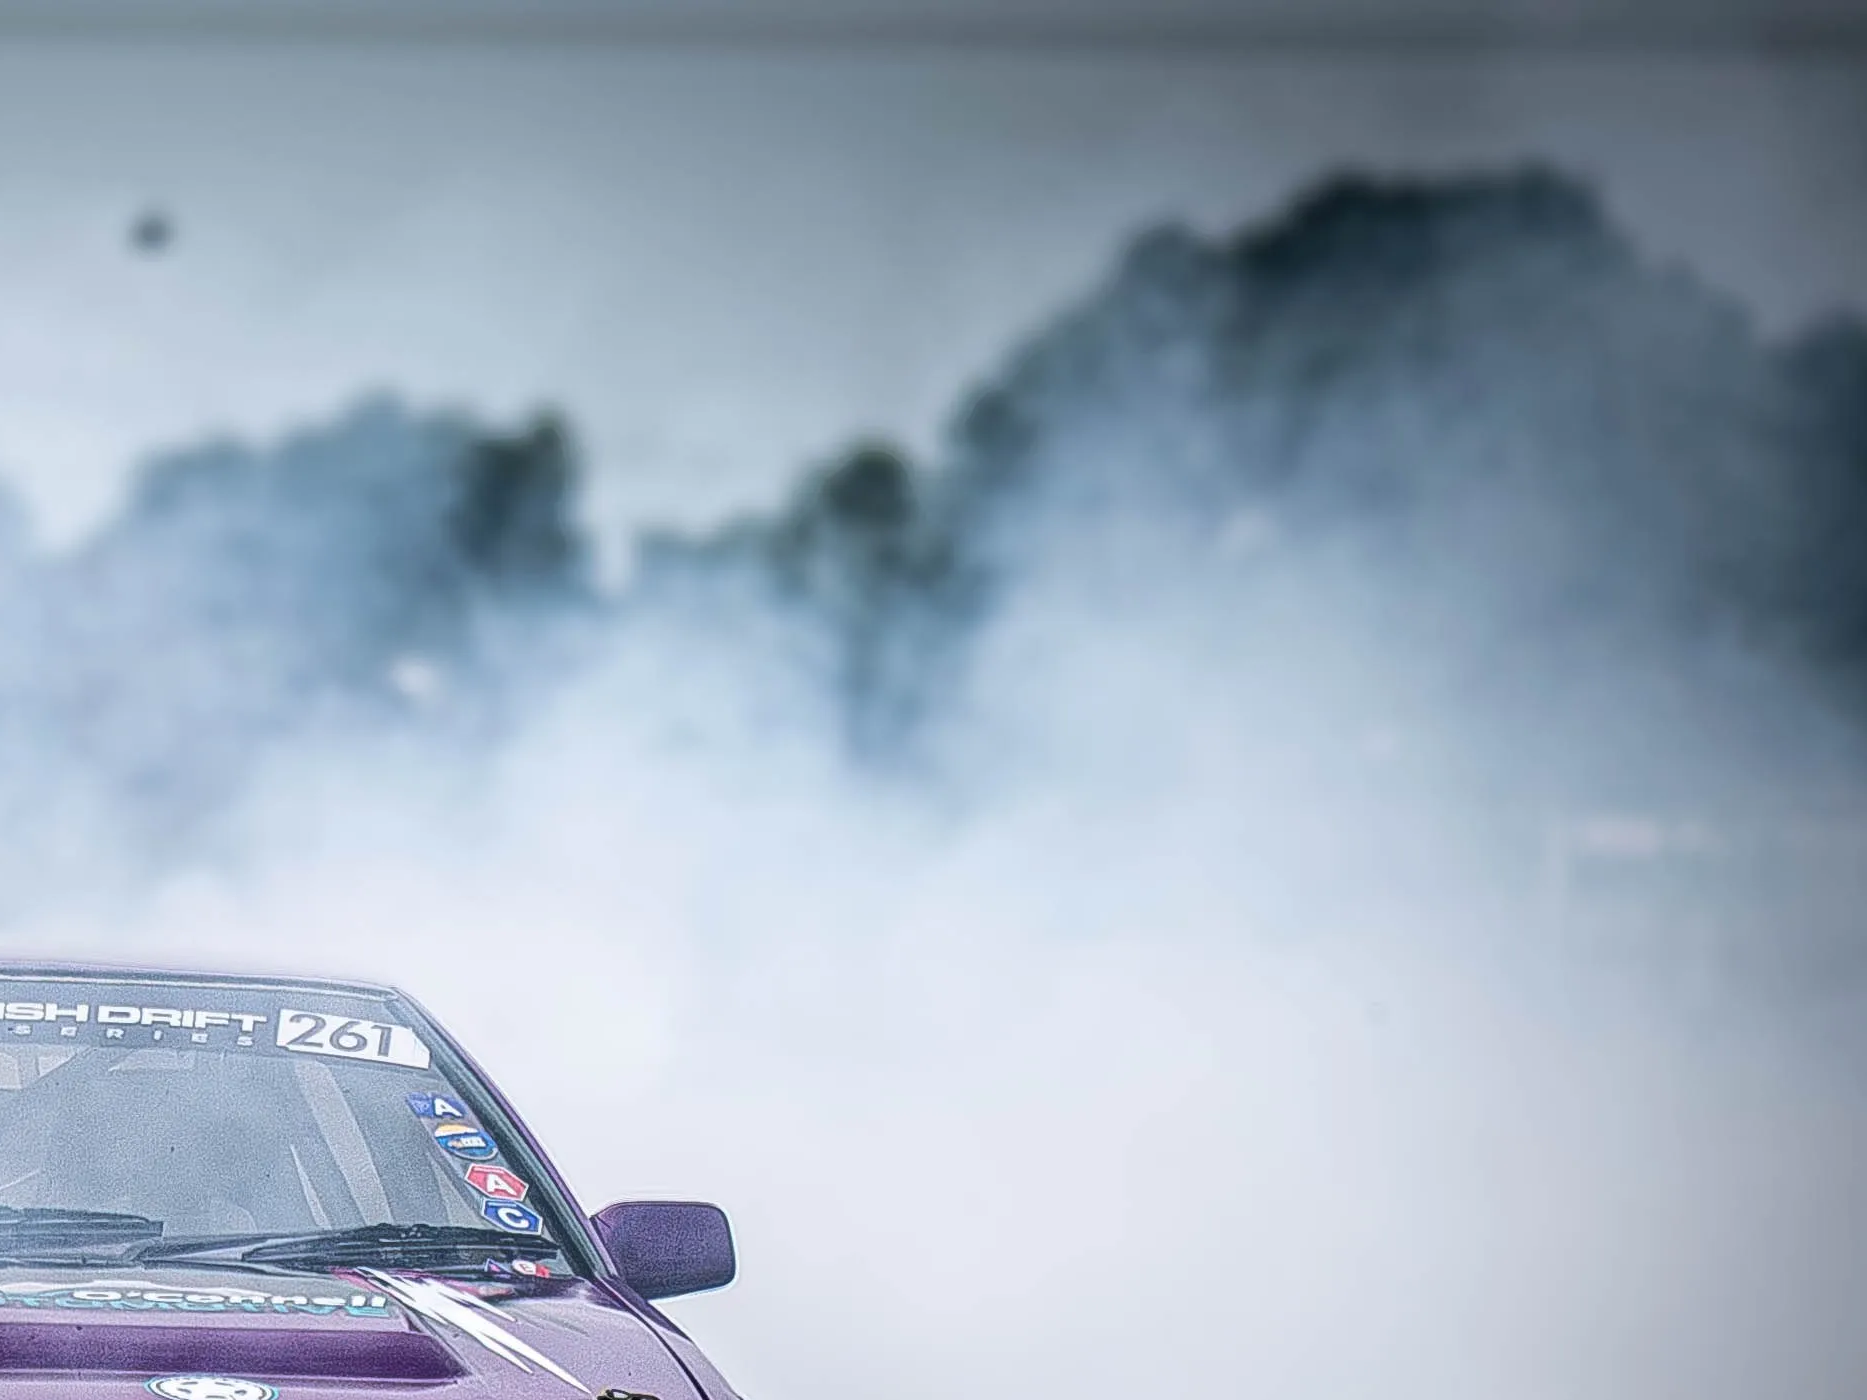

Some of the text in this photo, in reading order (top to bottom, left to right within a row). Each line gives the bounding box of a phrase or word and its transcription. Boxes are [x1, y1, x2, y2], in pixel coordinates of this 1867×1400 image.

[97, 1005, 268, 1031] DRIFT
[13, 1025, 254, 1046] SERIES
[289, 1013, 393, 1057] 261
[487, 1173, 517, 1196] A
[497, 1207, 530, 1228] C
